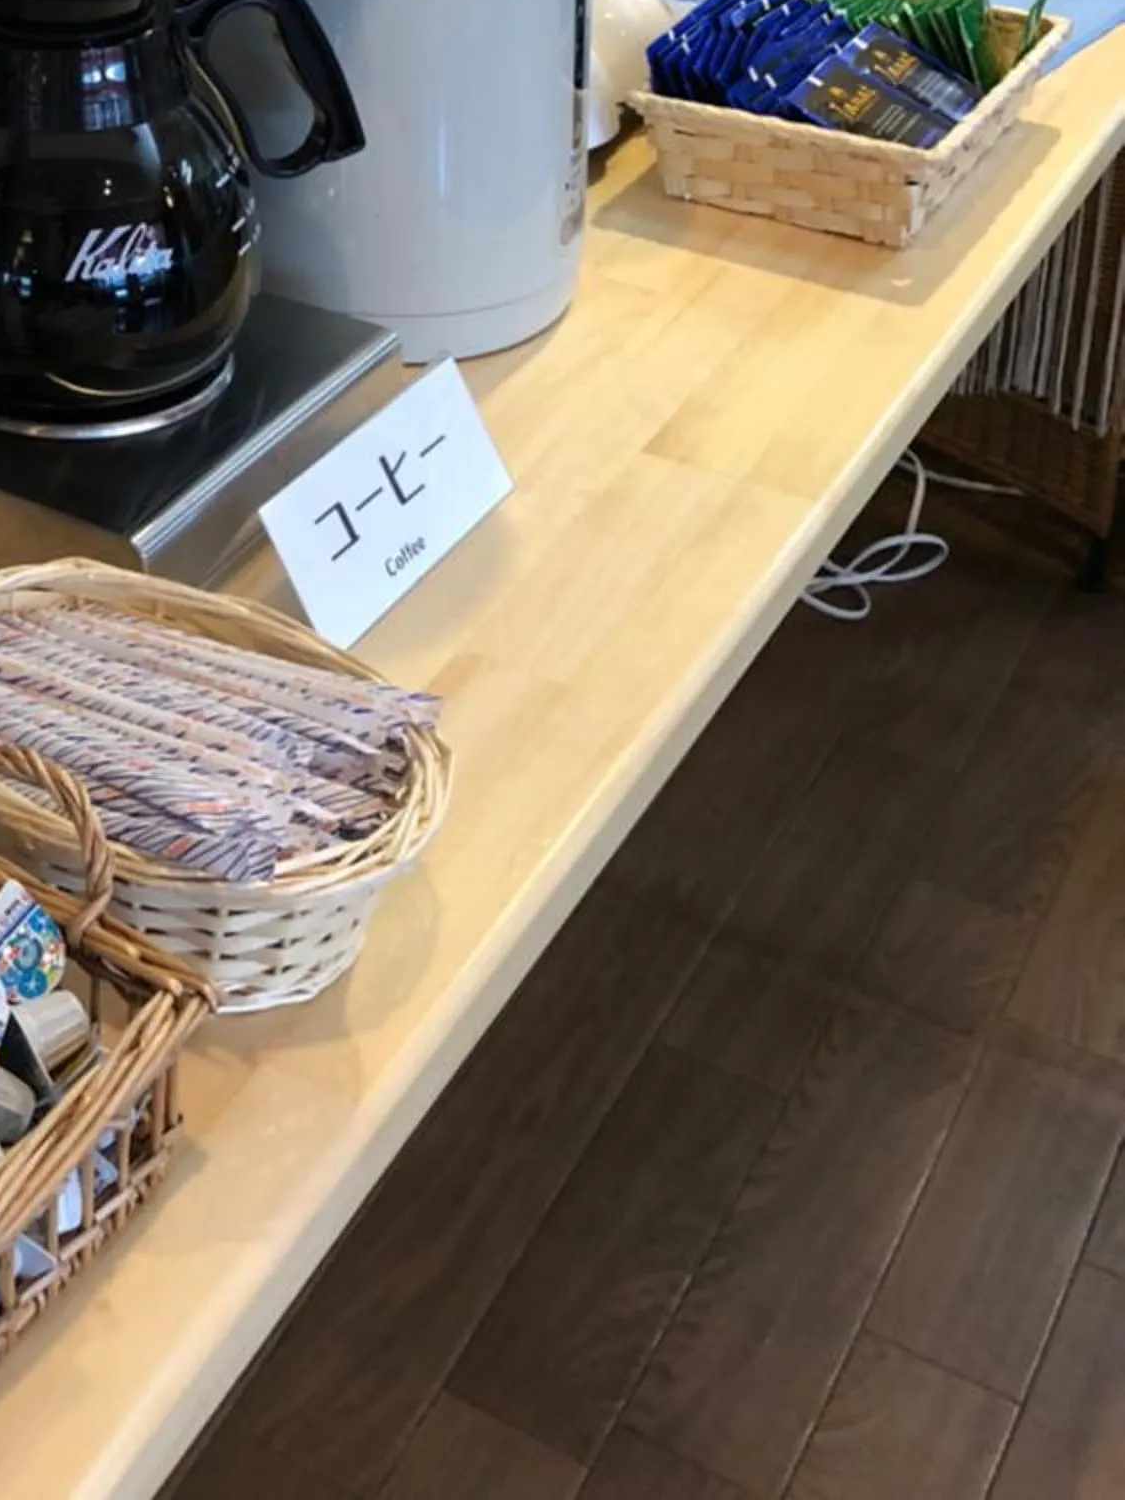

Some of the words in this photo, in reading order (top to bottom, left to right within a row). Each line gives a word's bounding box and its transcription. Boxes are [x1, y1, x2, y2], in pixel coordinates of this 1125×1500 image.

[64, 222, 174, 282] Kalita
[313, 433, 447, 562] コーヒー
[383, 534, 428, 578] Coffee
